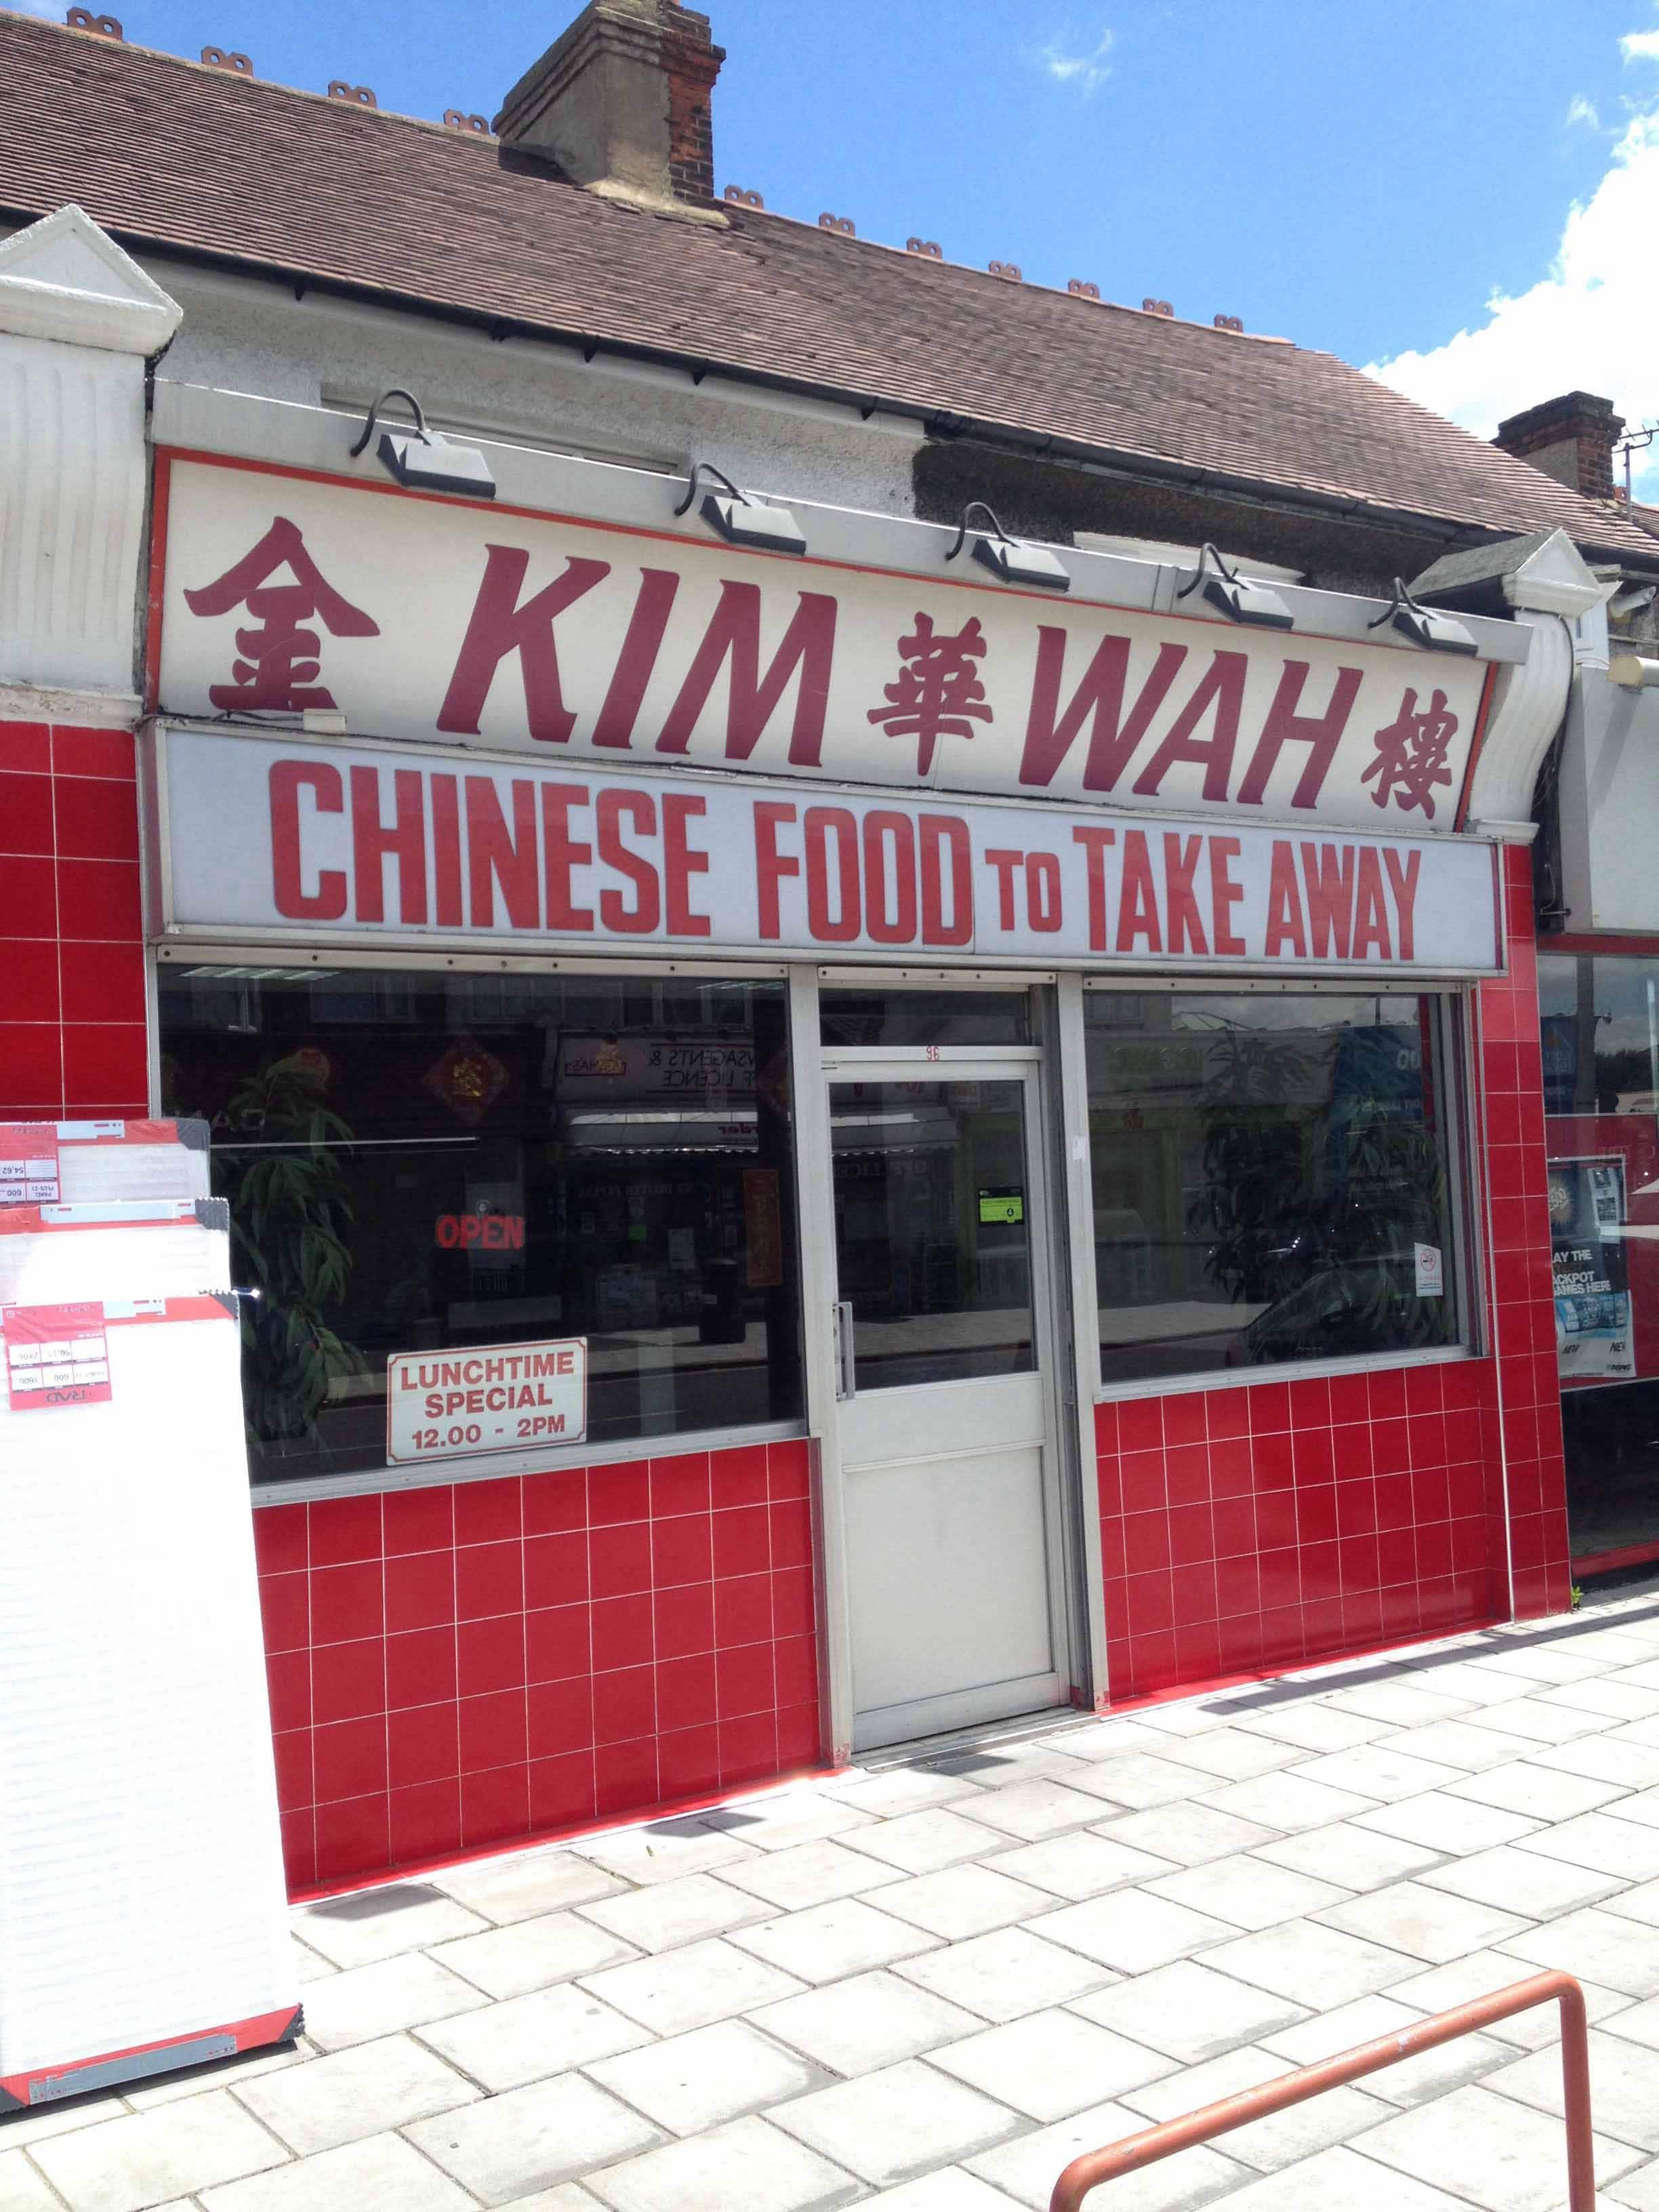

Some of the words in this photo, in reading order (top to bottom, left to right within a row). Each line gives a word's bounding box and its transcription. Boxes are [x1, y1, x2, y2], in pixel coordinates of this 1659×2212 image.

[184, 516, 381, 712] 金
[436, 544, 838, 766] KIM
[867, 611, 994, 777] 華
[1019, 626, 1364, 809] WAH
[269, 760, 712, 938] CHINESE
[754, 801, 975, 947] FOOD
[985, 850, 1063, 933] TO
[1073, 826, 1246, 956] TAKE
[1265, 840, 1421, 961] AWAY
[435, 1214, 525, 1250] OPEN
[1570, 1249, 1593, 1262] THE
[400, 1351, 574, 1391] LUNCHTIME
[424, 1383, 553, 1419] SPECIAL
[411, 1424, 482, 1450] 12.00
[517, 1414, 565, 1438] 2PM
